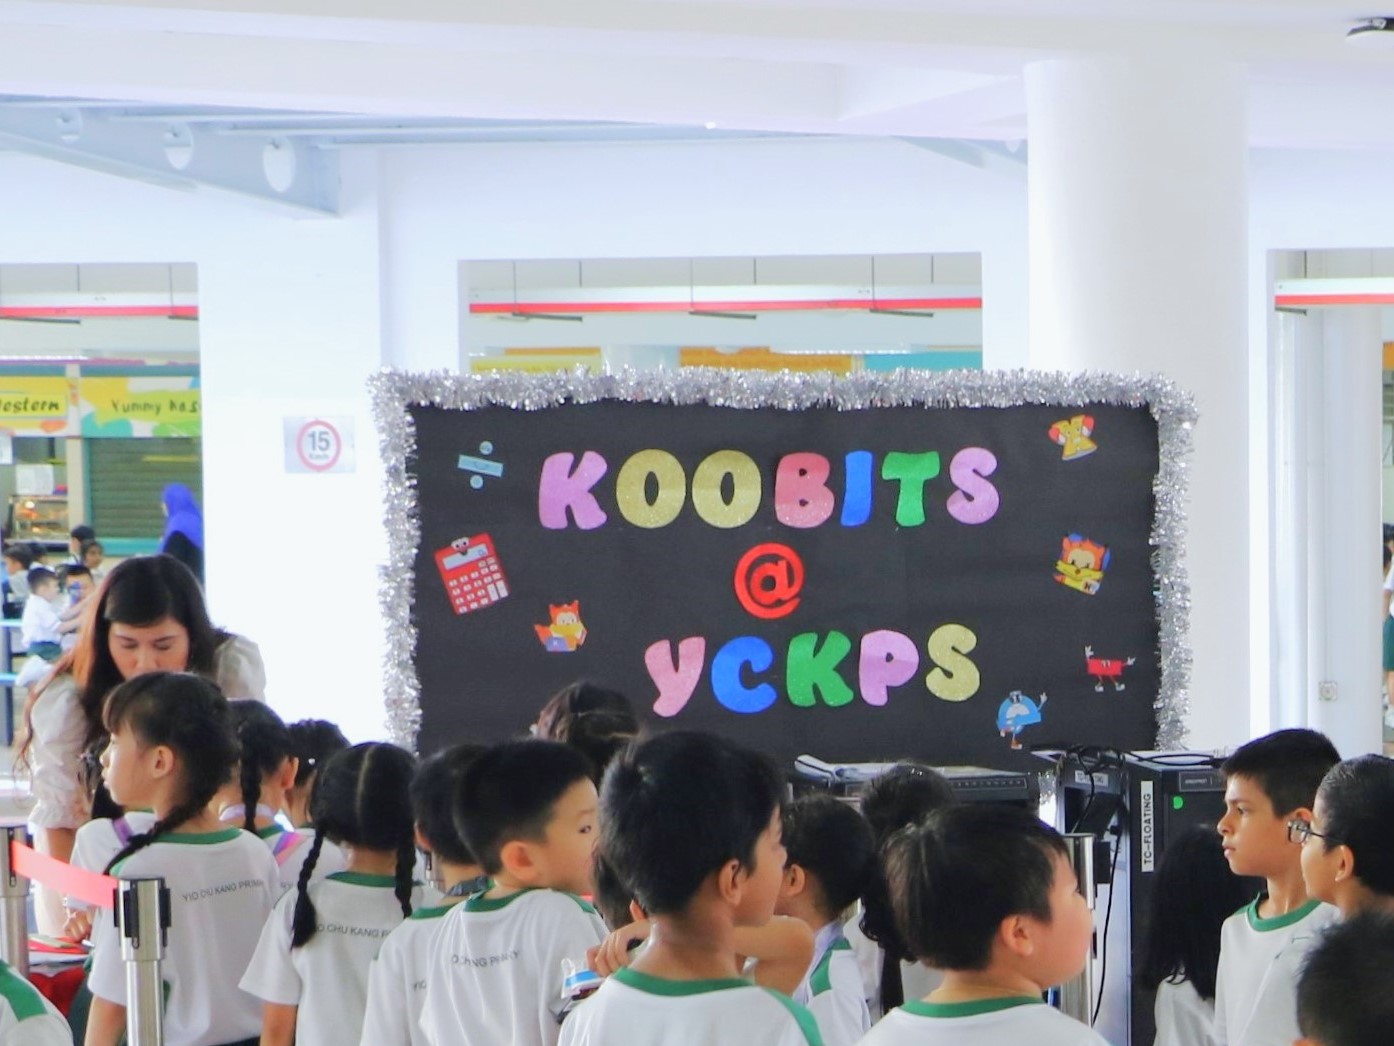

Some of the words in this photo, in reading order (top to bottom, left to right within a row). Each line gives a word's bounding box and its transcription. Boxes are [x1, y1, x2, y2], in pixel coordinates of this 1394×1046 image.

[0, 397, 60, 413] estern
[307, 430, 331, 452] 15
[538, 446, 1000, 531] KOOBITS
[734, 542, 805, 620] @
[644, 623, 981, 718] YCKPS
[1143, 793, 1152, 865] TC-FLOATING
